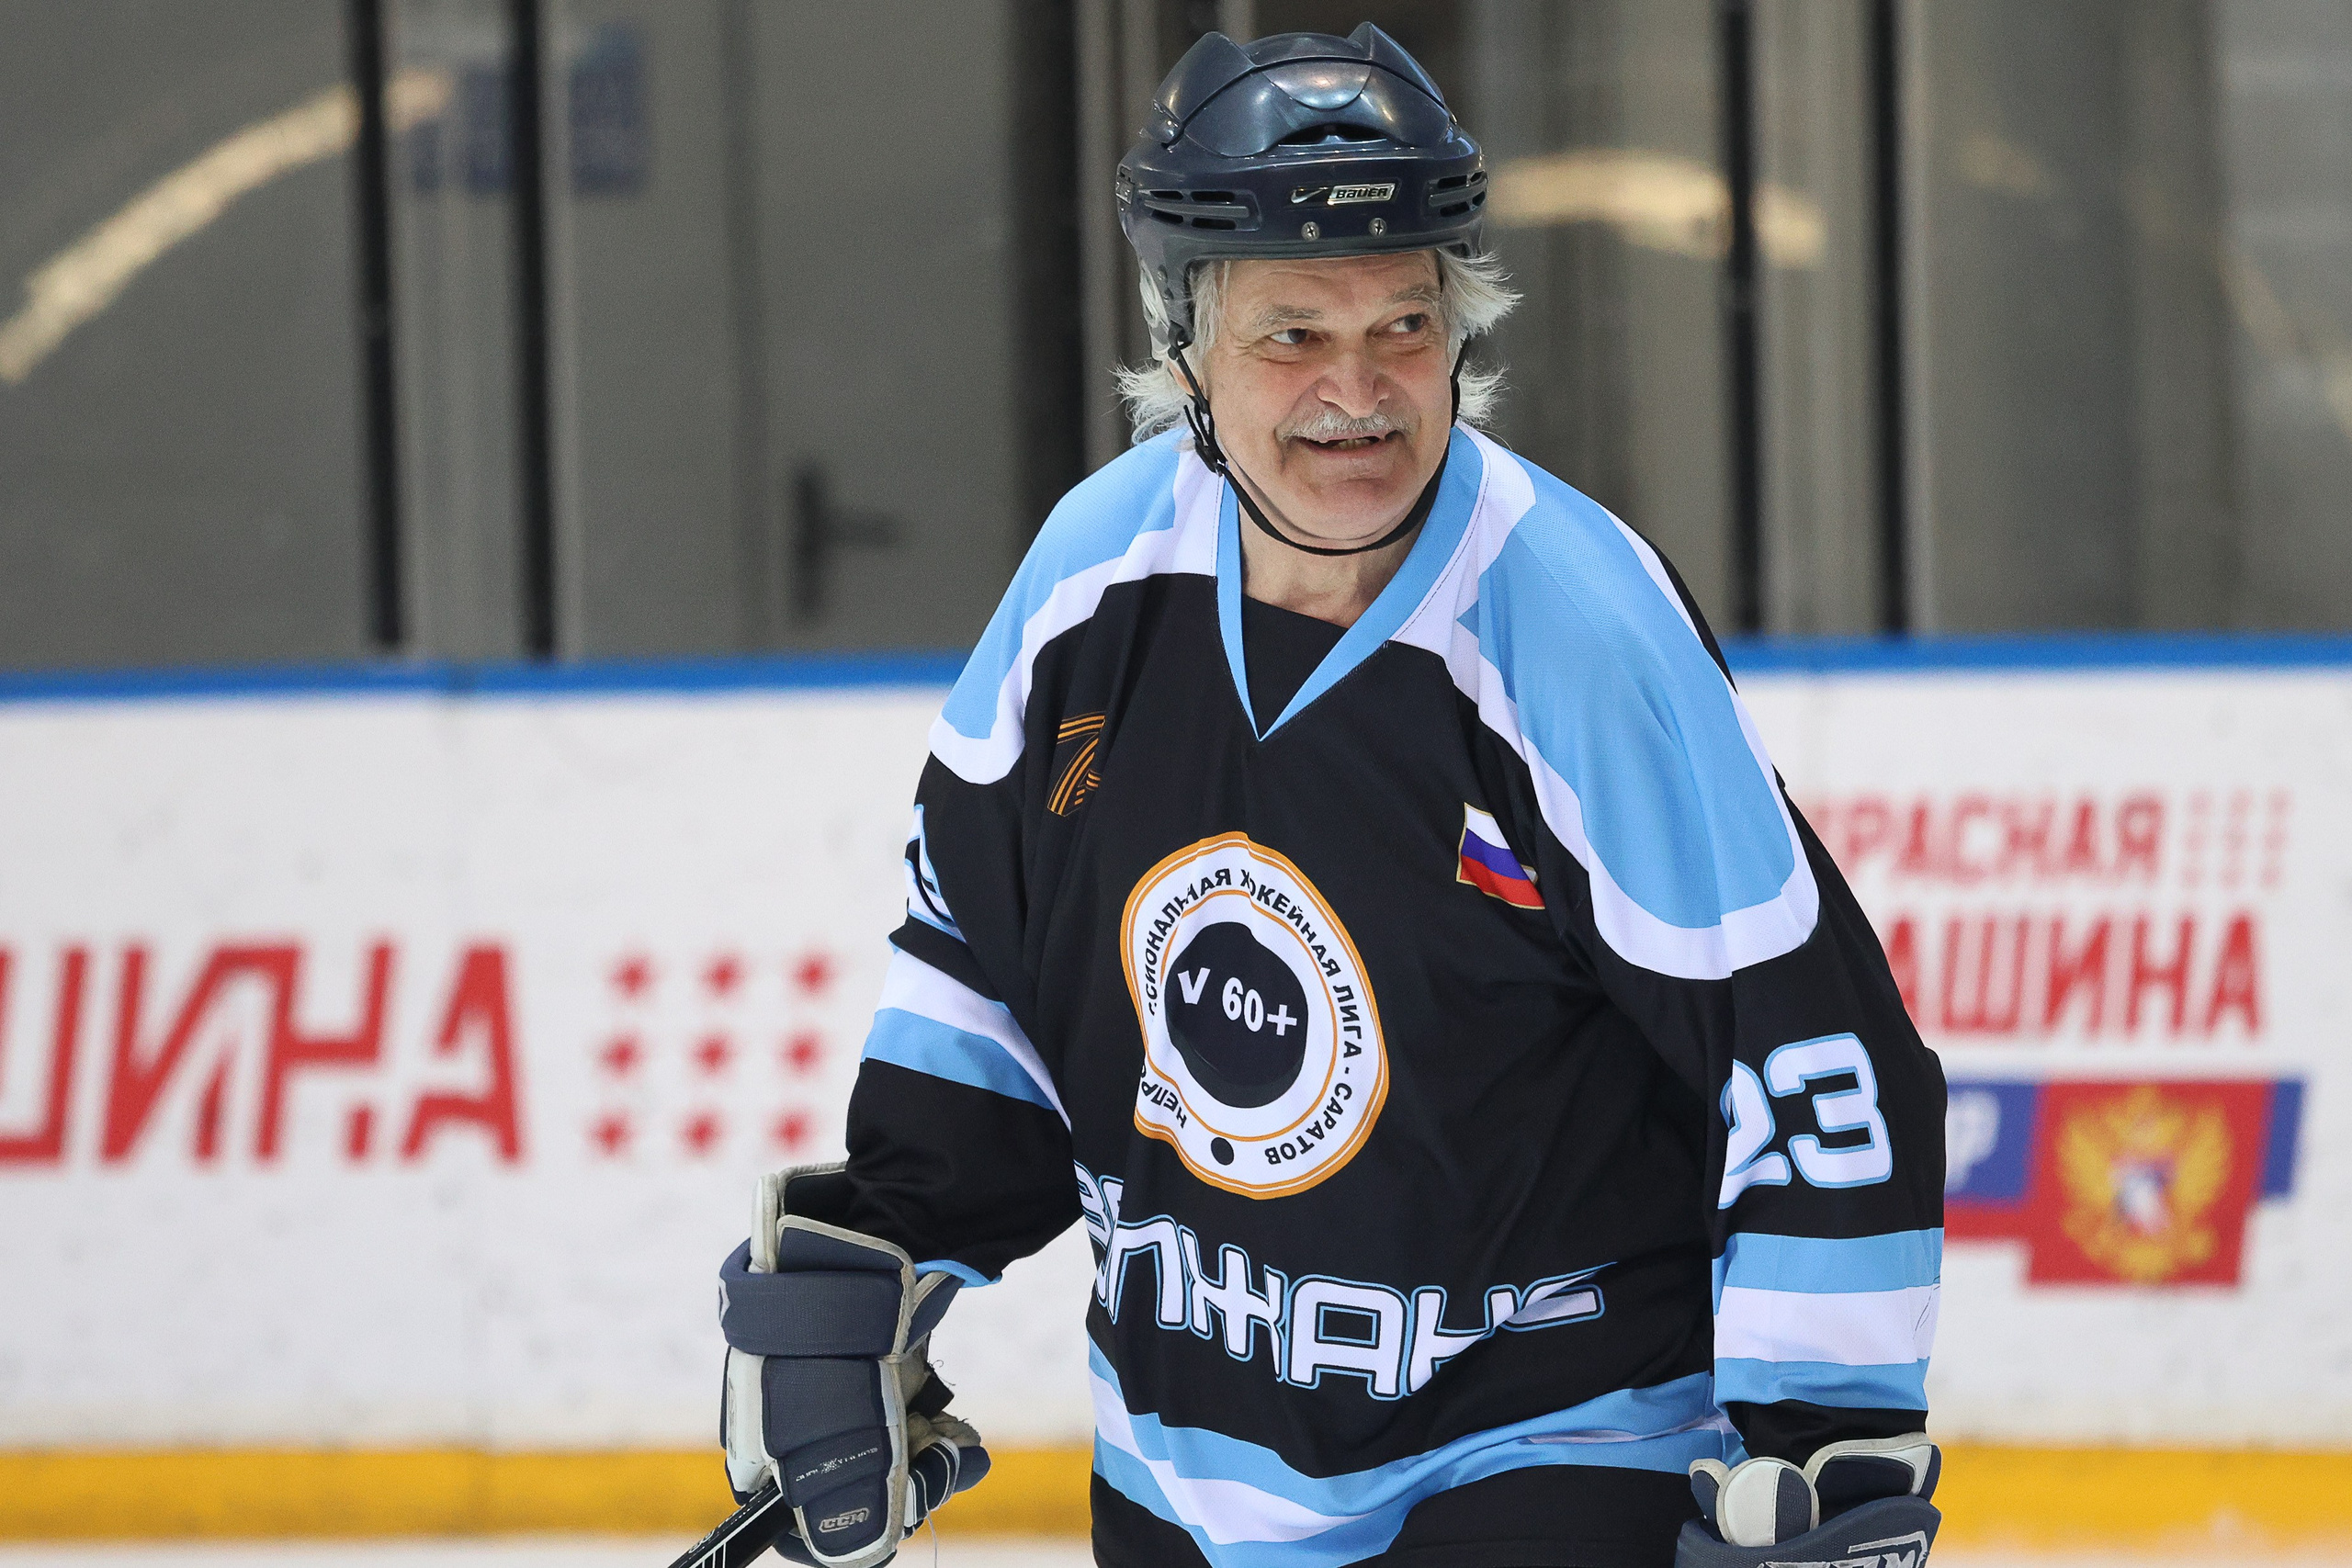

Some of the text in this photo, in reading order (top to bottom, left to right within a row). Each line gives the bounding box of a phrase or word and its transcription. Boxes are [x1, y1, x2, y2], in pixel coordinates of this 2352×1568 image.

[1222, 976, 1297, 1036] 60+
[1333, 985, 1363, 1058] ЛИГА
[1264, 1082, 1352, 1166] САРАТОВ
[1718, 1032, 1894, 1210] 23
